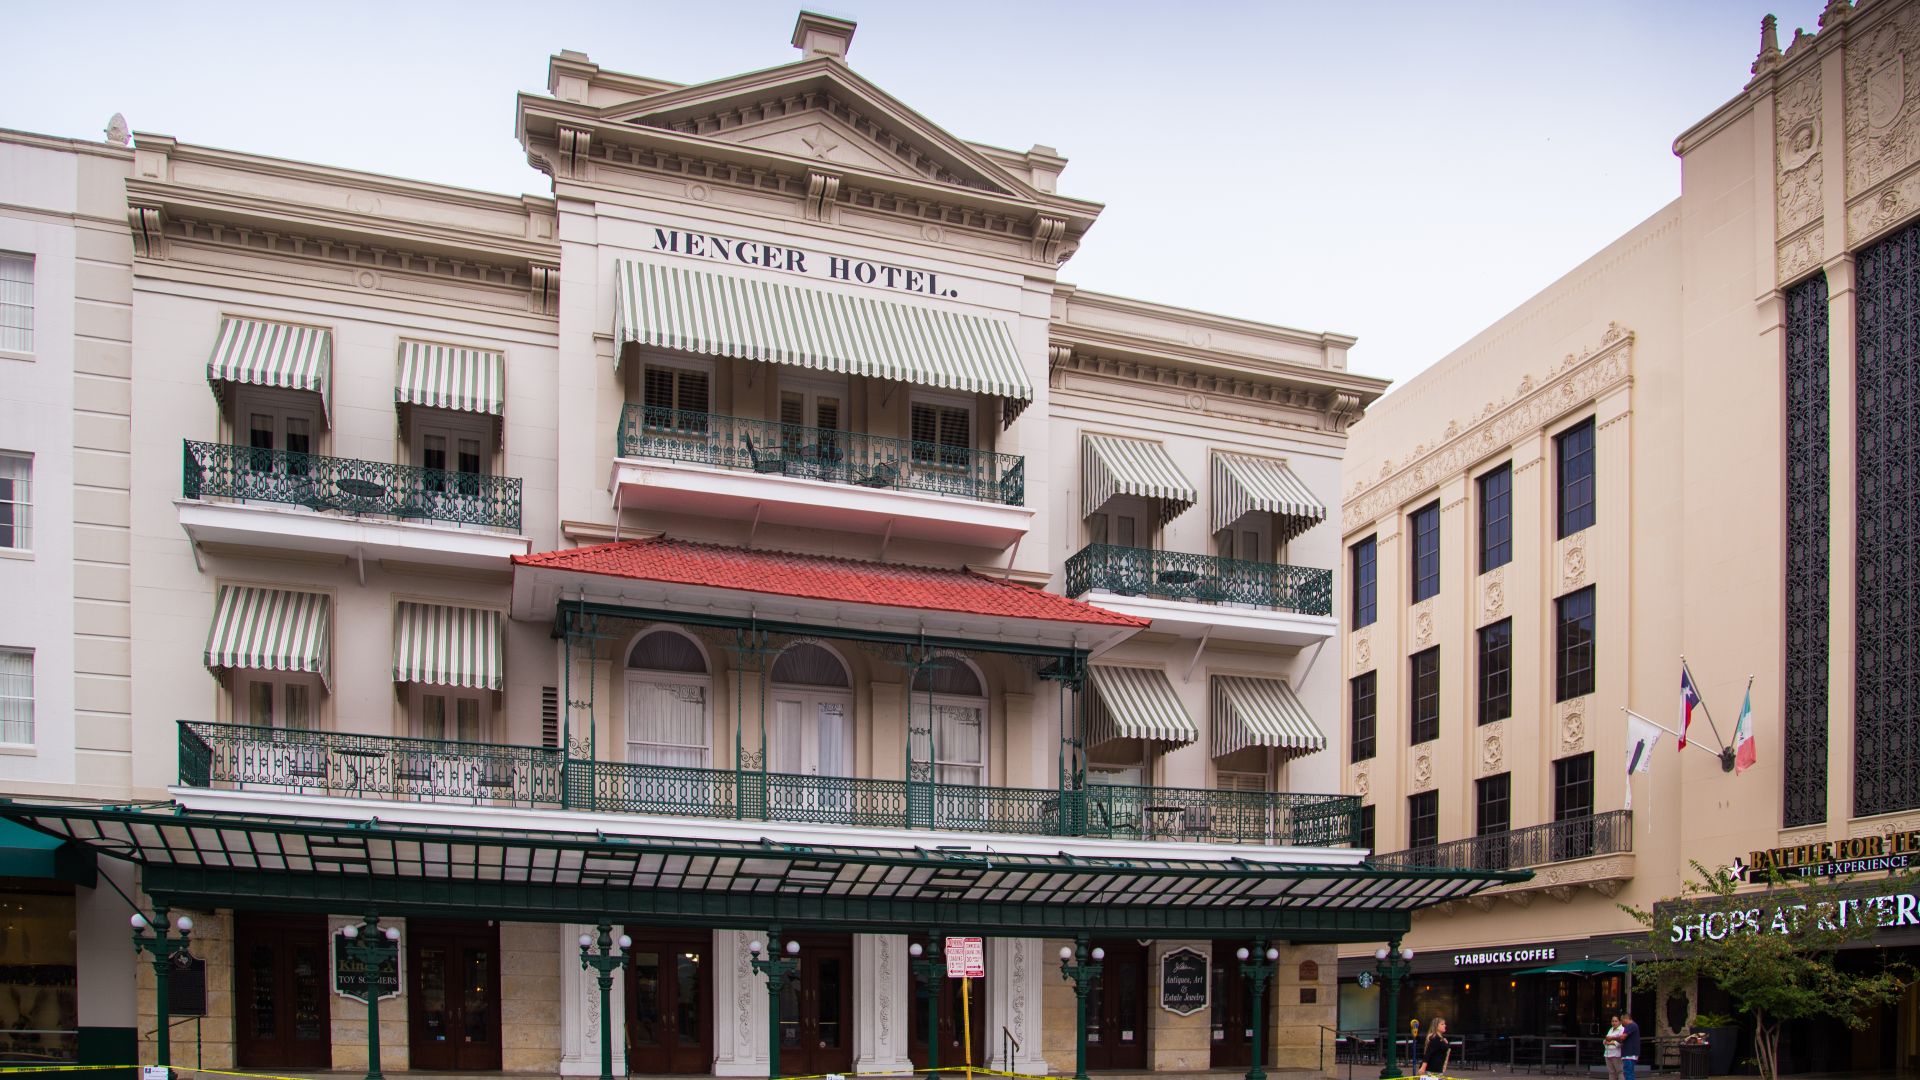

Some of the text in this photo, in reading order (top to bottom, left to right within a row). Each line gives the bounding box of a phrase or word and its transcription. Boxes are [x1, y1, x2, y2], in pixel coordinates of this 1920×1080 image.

[652, 228, 958, 298] MENGER HOTEL.
[1749, 841, 1832, 870] BATTLE
[1834, 835, 1882, 860] FOR
[1828, 856, 1908, 875] EXPERIENCE
[1670, 894, 1920, 942] SHOPS AT RIVER
[1454, 948, 1555, 966] STARBUCKS COFFEE
[339, 976, 355, 984] TOY
[1193, 975, 1203, 984] Art
[1164, 993, 1183, 1002] Estate
